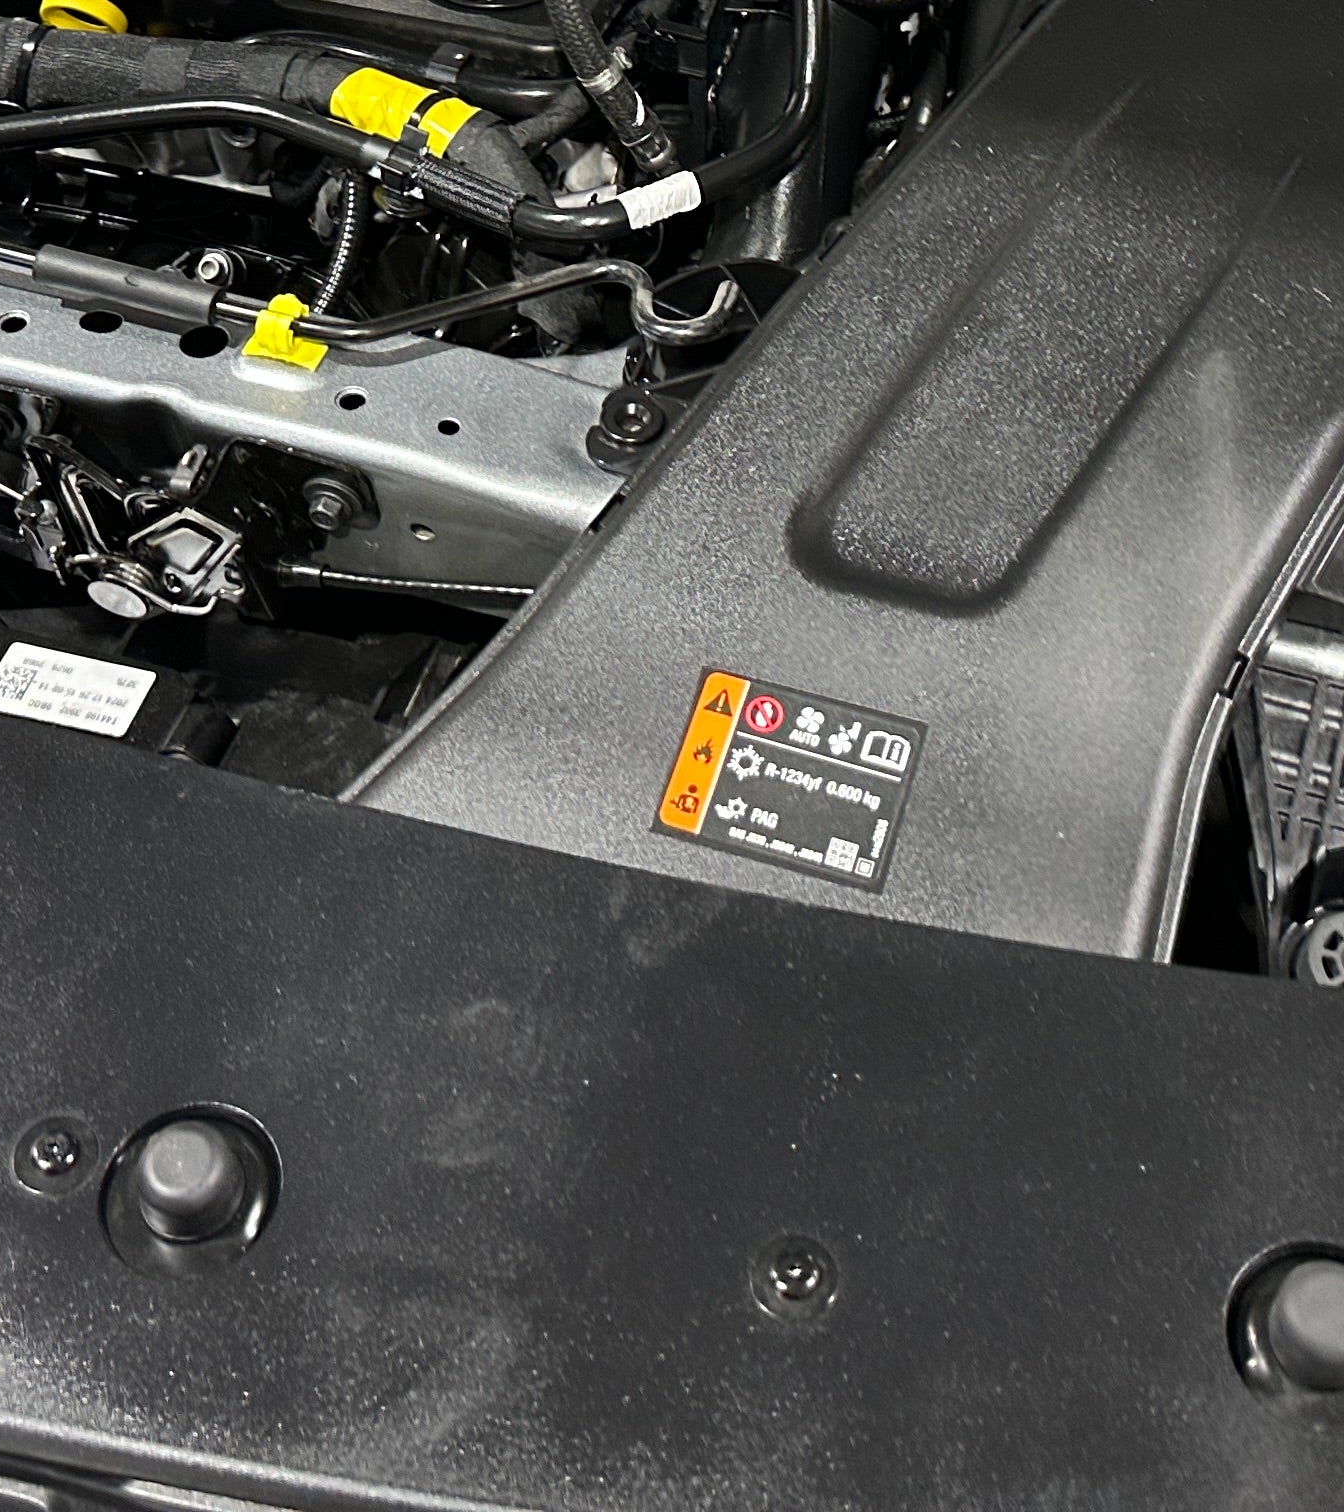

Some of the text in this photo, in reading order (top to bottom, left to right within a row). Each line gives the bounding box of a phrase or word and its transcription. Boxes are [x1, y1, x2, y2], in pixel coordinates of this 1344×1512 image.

[790, 728, 820, 747] AUTO
[764, 762, 823, 792] R-1234yf
[862, 790, 881, 811] kg
[750, 807, 779, 829] PAG
